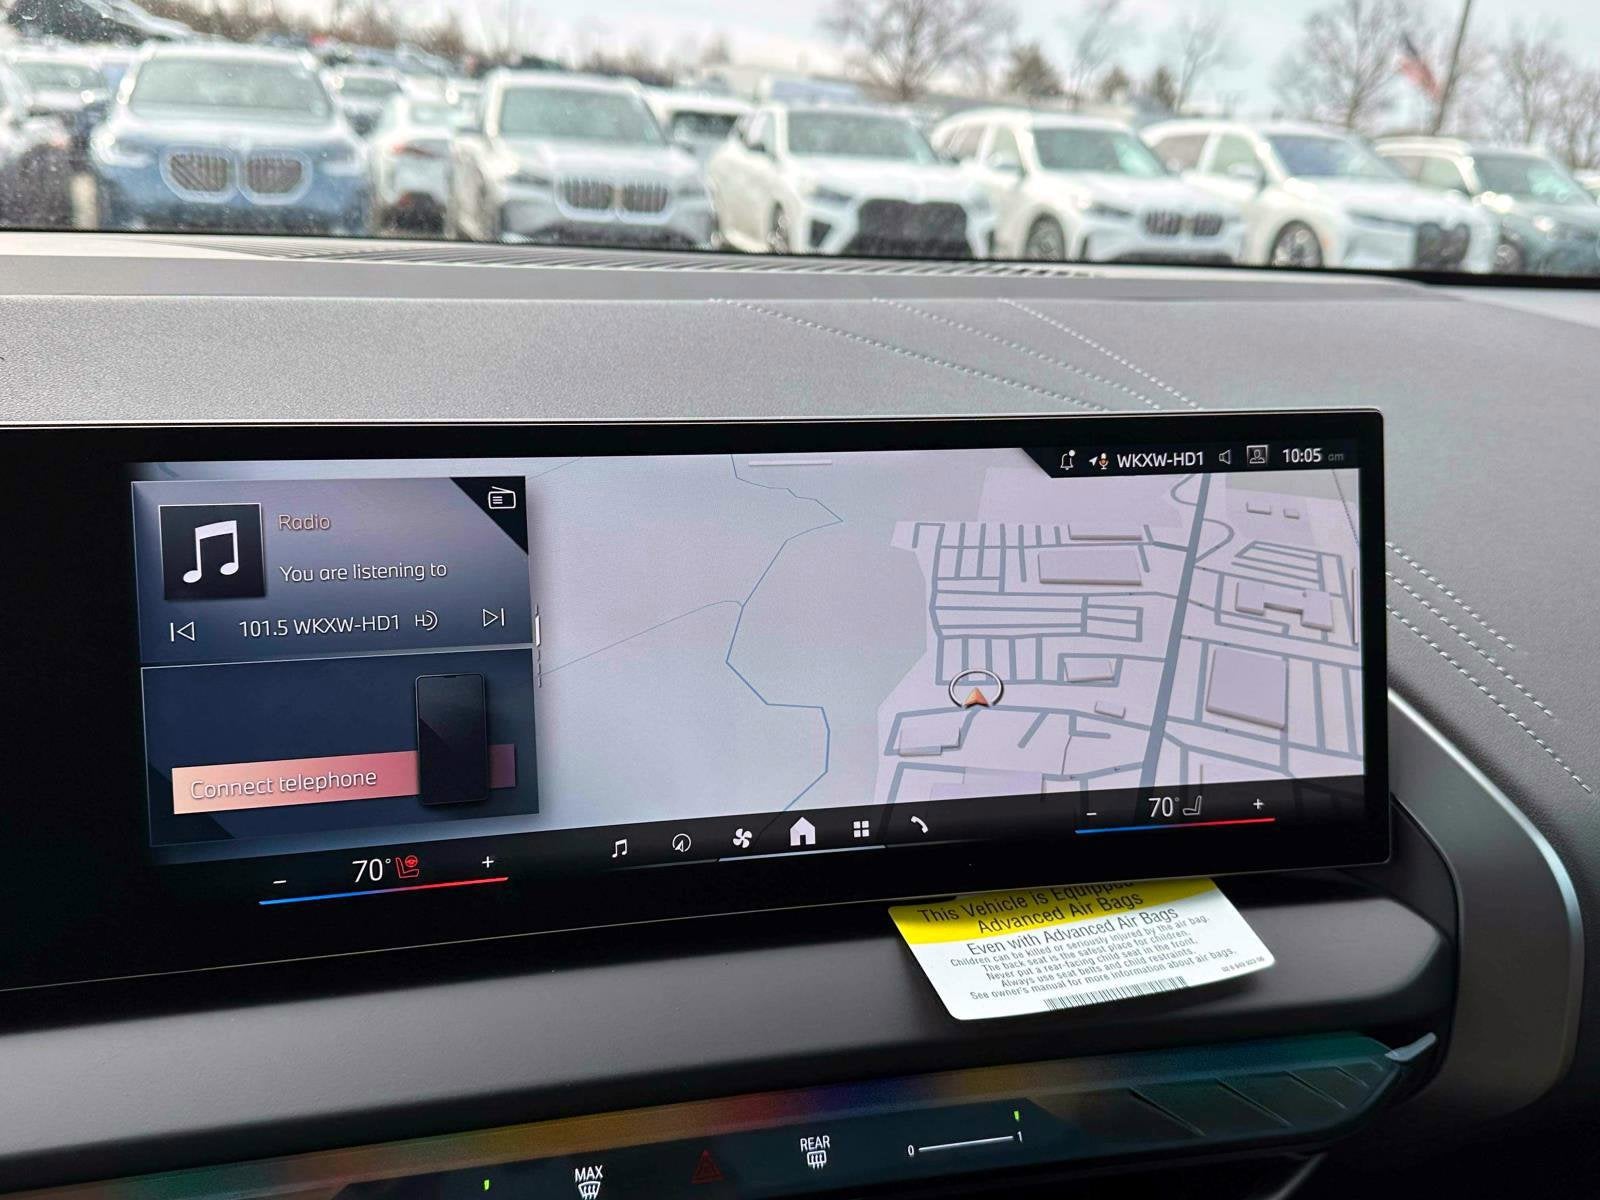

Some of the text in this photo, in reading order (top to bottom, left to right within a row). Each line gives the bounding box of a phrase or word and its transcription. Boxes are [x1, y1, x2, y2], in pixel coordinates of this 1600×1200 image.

[1117, 451, 1204, 468] WKXW-HD1
[1282, 448, 1322, 463] 10:05
[278, 514, 331, 532] Radio
[279, 562, 448, 583] You are listening to
[238, 619, 288, 638] 101.5
[293, 613, 401, 635] WKXW-HD1
[190, 769, 378, 801] Connect telephone
[917, 907, 959, 922] This
[961, 895, 1028, 918] Vehicle
[1029, 890, 1049, 905] is
[978, 892, 1144, 934] Advanced Air Bags
[950, 914, 1210, 967] Children can be killed or seriously injured by the air bag.
[967, 907, 1179, 956] Even with Advanced Air Bags
[982, 930, 1191, 973] The back seat is the safest place for children.
[986, 970, 1017, 981] Never
[1018, 968, 1033, 978] put
[1043, 957, 1095, 974] rear-facing
[1097, 952, 1120, 963] child
[1122, 948, 1142, 959] seat
[1143, 946, 1153, 955] in
[1154, 942, 1170, 952] the
[970, 948, 1237, 1000] See owner's manual for more information about air bags.
[1001, 948, 1196, 988] Always use seat belts and child restraints.
[800, 1135, 831, 1152] REAR
[574, 1165, 603, 1183] MAX
